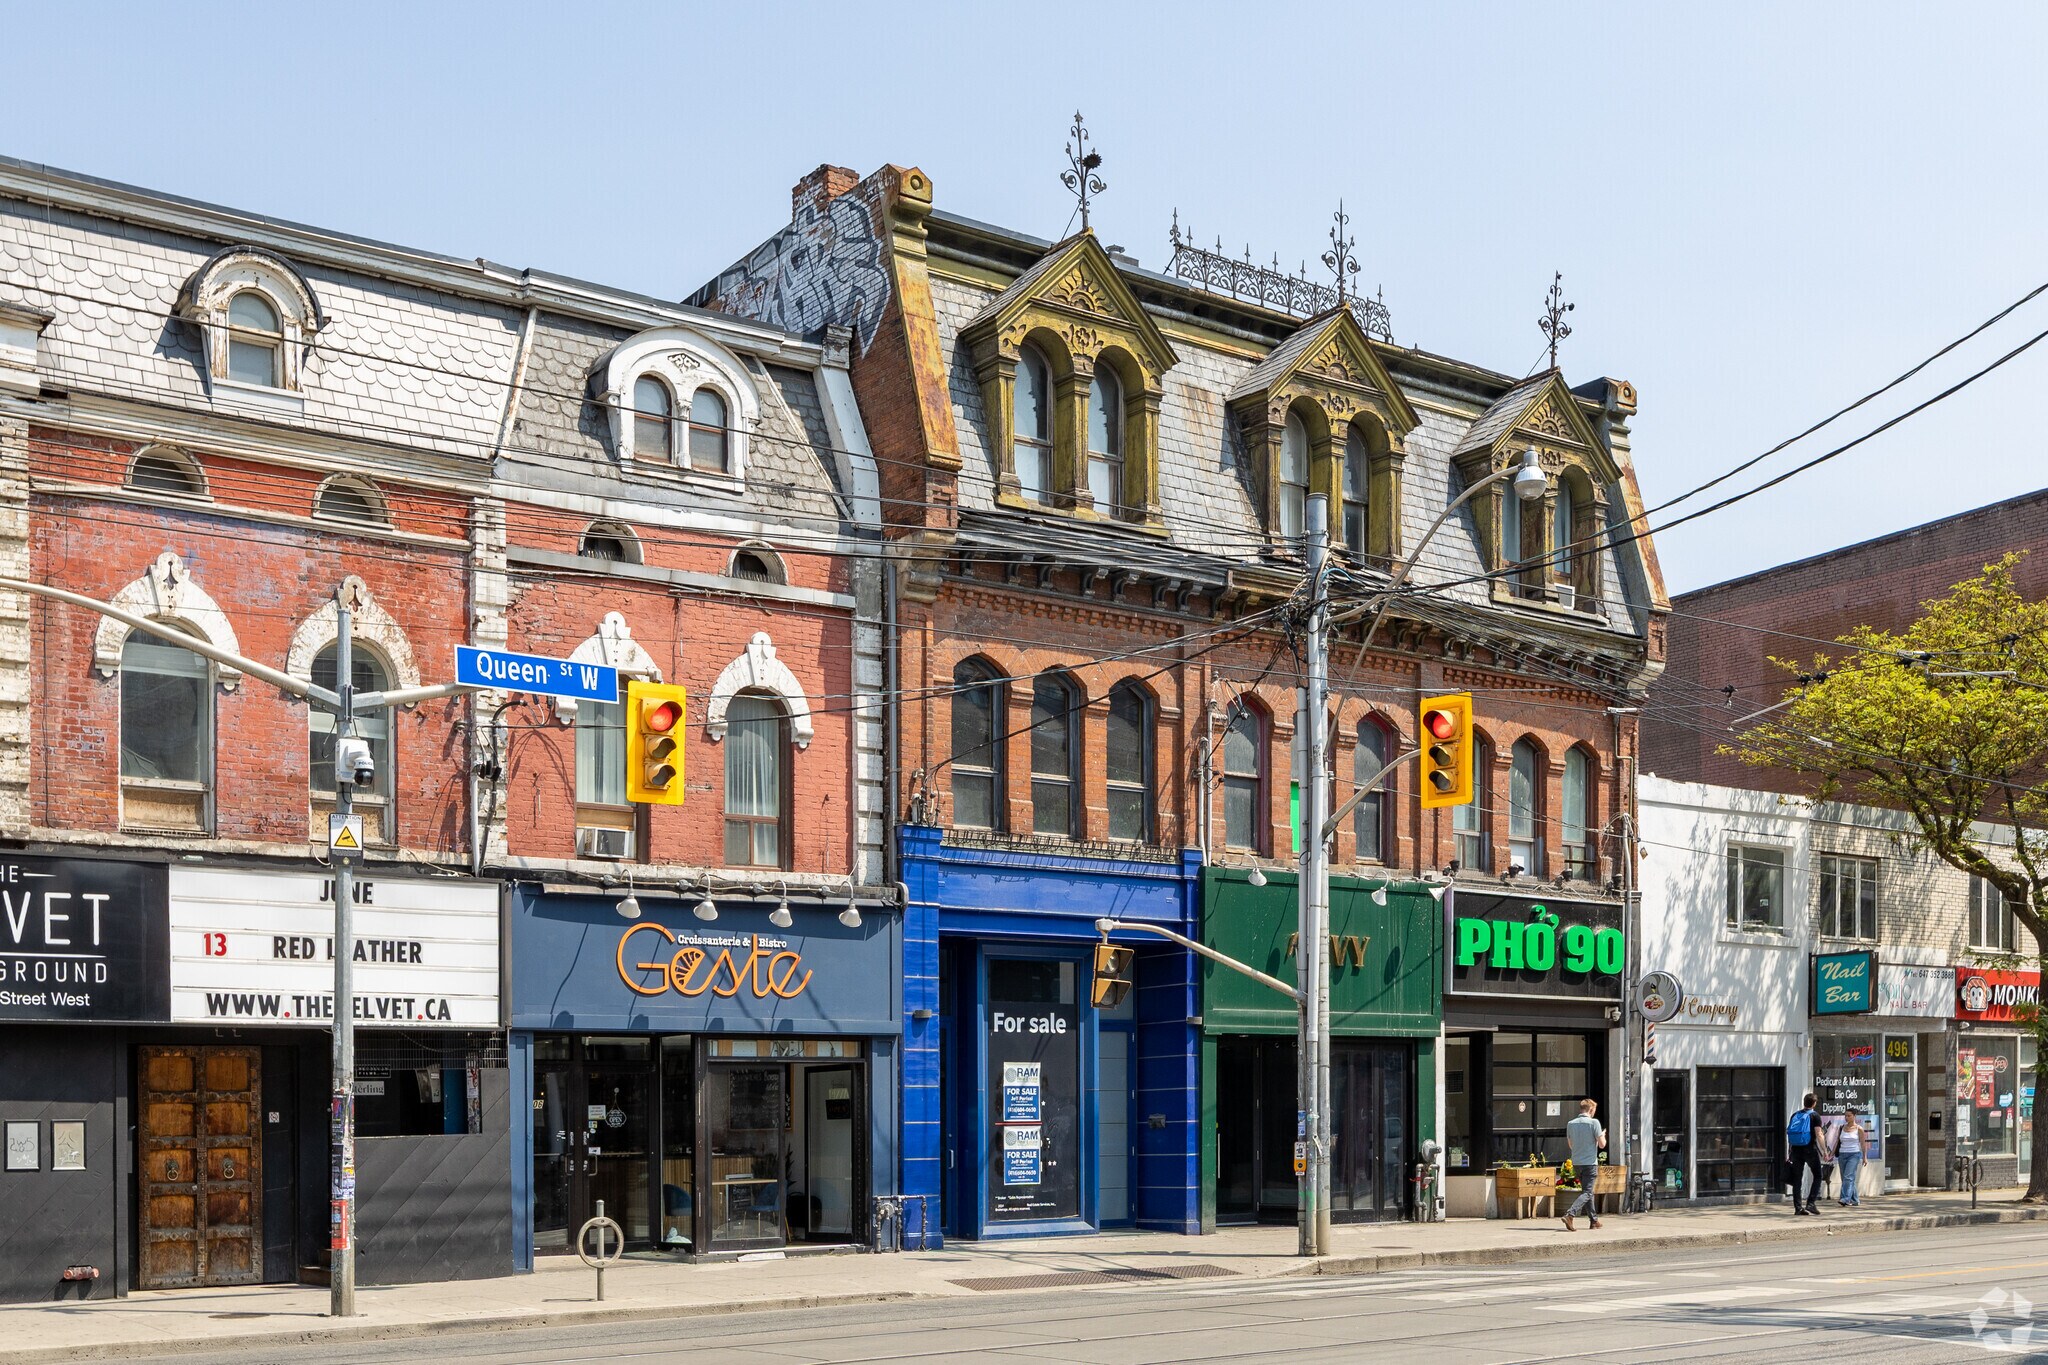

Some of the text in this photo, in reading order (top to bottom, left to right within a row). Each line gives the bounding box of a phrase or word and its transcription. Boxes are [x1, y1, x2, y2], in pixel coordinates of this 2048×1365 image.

[476, 651, 599, 691] Queen St W
[203, 932, 422, 964] 13 RED LATHER
[677, 934, 787, 948] Croissanterie & Bistro
[1562, 925, 1624, 975] 90
[616, 921, 814, 998] Geste
[1821, 961, 1866, 980] Nail
[1919, 969, 1930, 979] 647
[0, 991, 90, 1006] Street West
[1825, 985, 1861, 1004] Bar
[1994, 984, 2040, 1006] MONK
[206, 993, 452, 1021] WWW.THEELVET.CA
[1890, 1000, 1928, 1009] NAIL BAR
[993, 1012, 1067, 1034] For sale
[1887, 1041, 1908, 1058] 496
[1017, 1068, 1038, 1076] RAM
[354, 1084, 384, 1094] terling
[1816, 1077, 1876, 1087] Pedicure & Manicure
[1835, 1090, 1857, 1099] Bio Gels
[1823, 1103, 1846, 1113] Dipping
[1017, 1131, 1038, 1140] RAM
